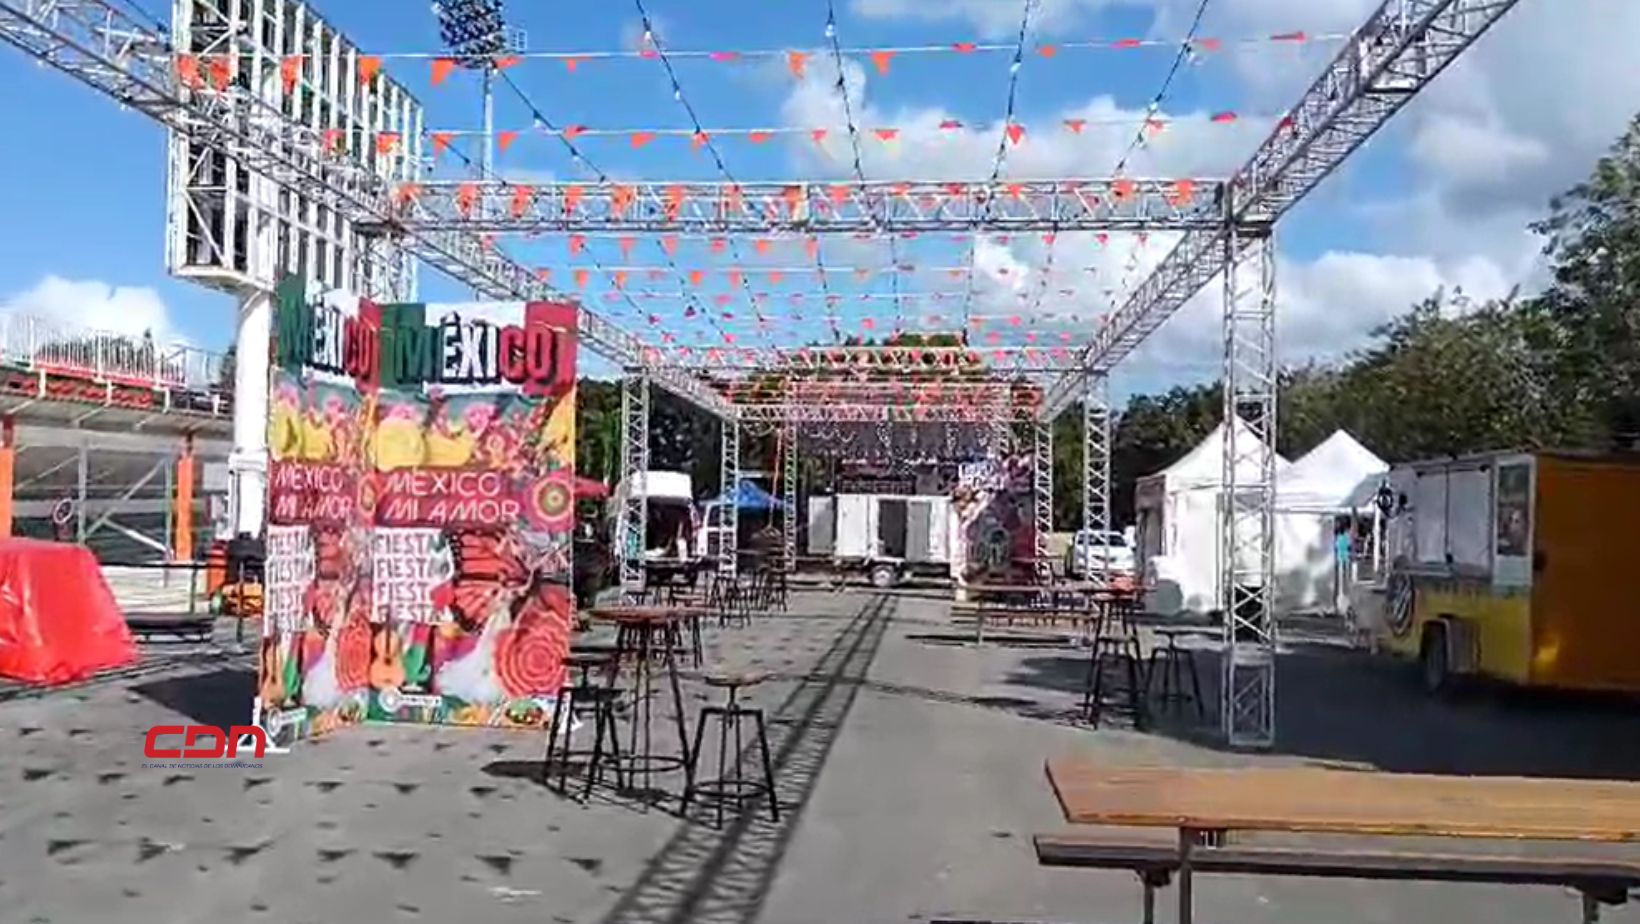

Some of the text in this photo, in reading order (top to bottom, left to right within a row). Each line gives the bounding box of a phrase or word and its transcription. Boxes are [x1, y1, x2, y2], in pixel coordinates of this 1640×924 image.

[396, 312, 558, 384] MÉXICO
[274, 465, 344, 490] MEXICO
[383, 472, 500, 497] MEXICO
[384, 499, 520, 522] MI AMOR
[376, 582, 430, 603] FIEST
